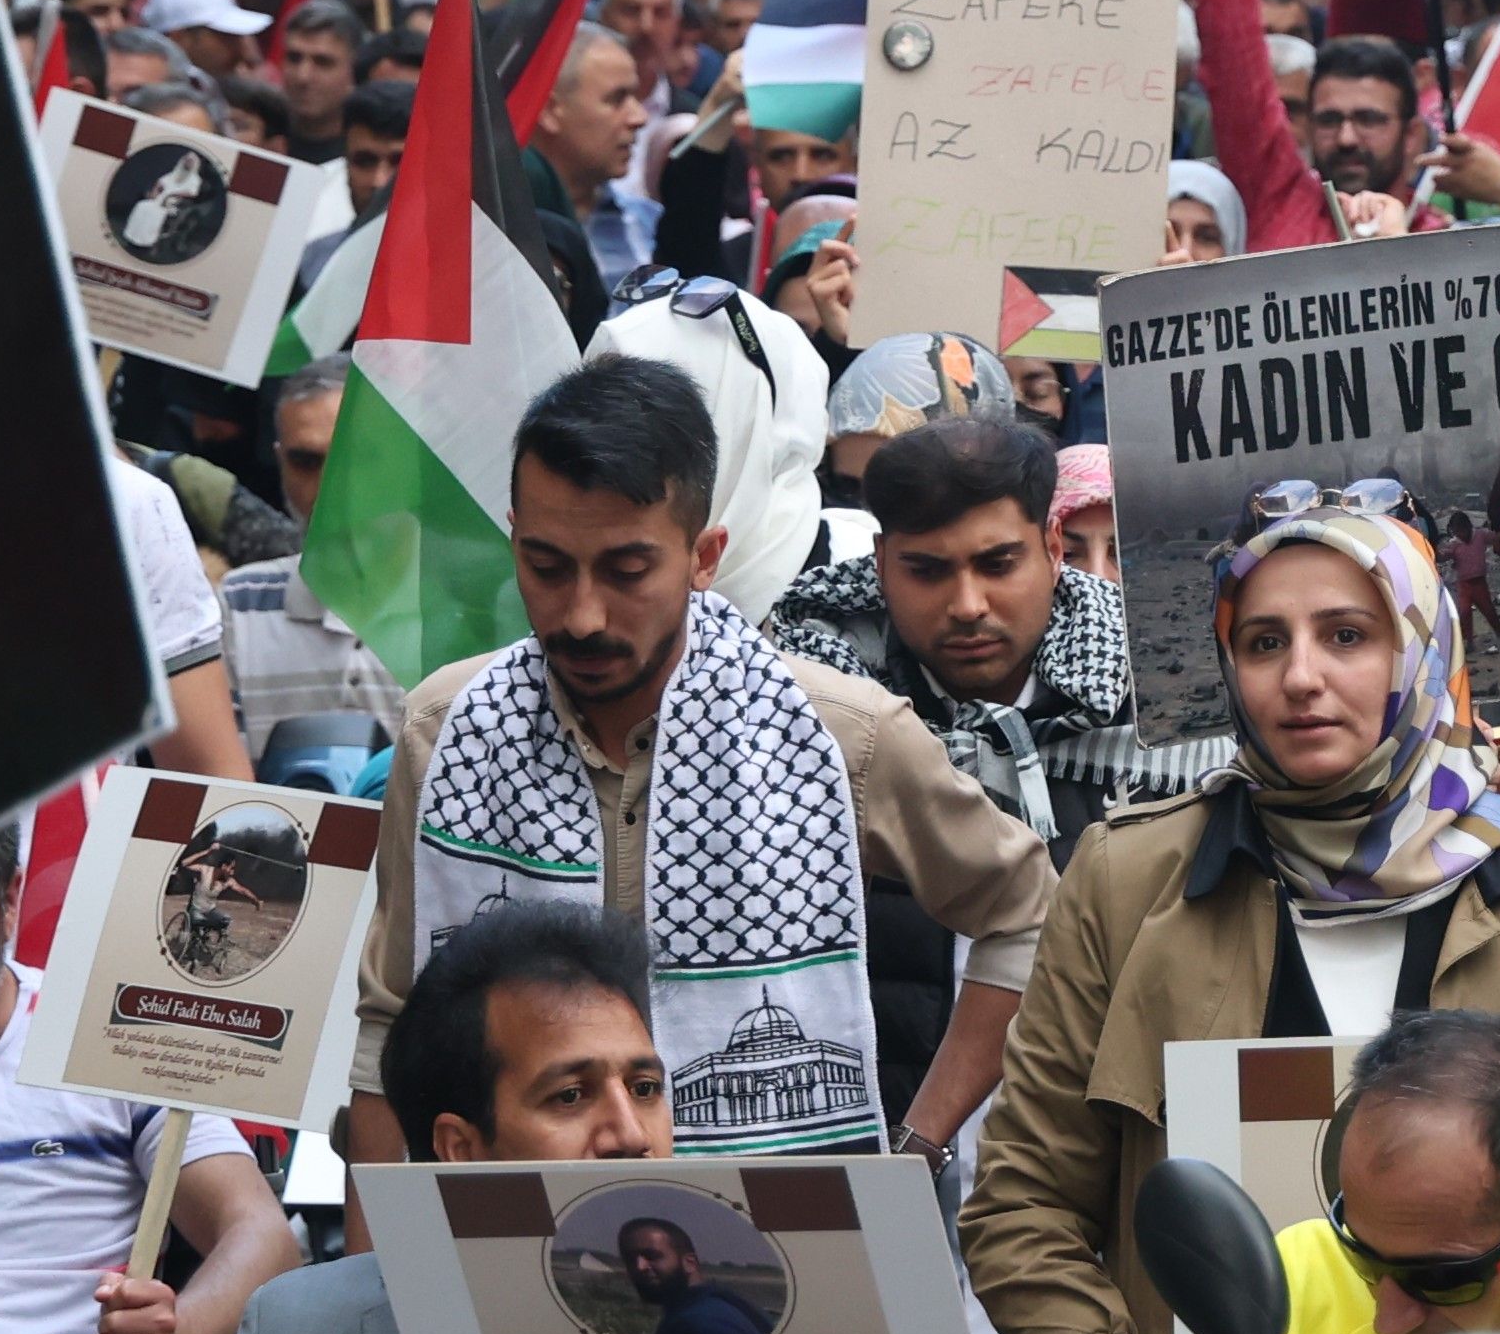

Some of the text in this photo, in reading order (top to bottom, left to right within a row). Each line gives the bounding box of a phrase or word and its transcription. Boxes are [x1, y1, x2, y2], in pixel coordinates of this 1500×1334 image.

[966, 65, 1169, 103] ZAFERE
[888, 111, 1164, 173] AZ KALDI
[877, 197, 1118, 261] ZAFERE
[1262, 272, 1435, 345] ÖLENLERİN
[1171, 347, 1371, 464] KADIN
[1390, 334, 1473, 435] VE
[136, 994, 262, 1030] Şehid Fadi Ebu Salah
